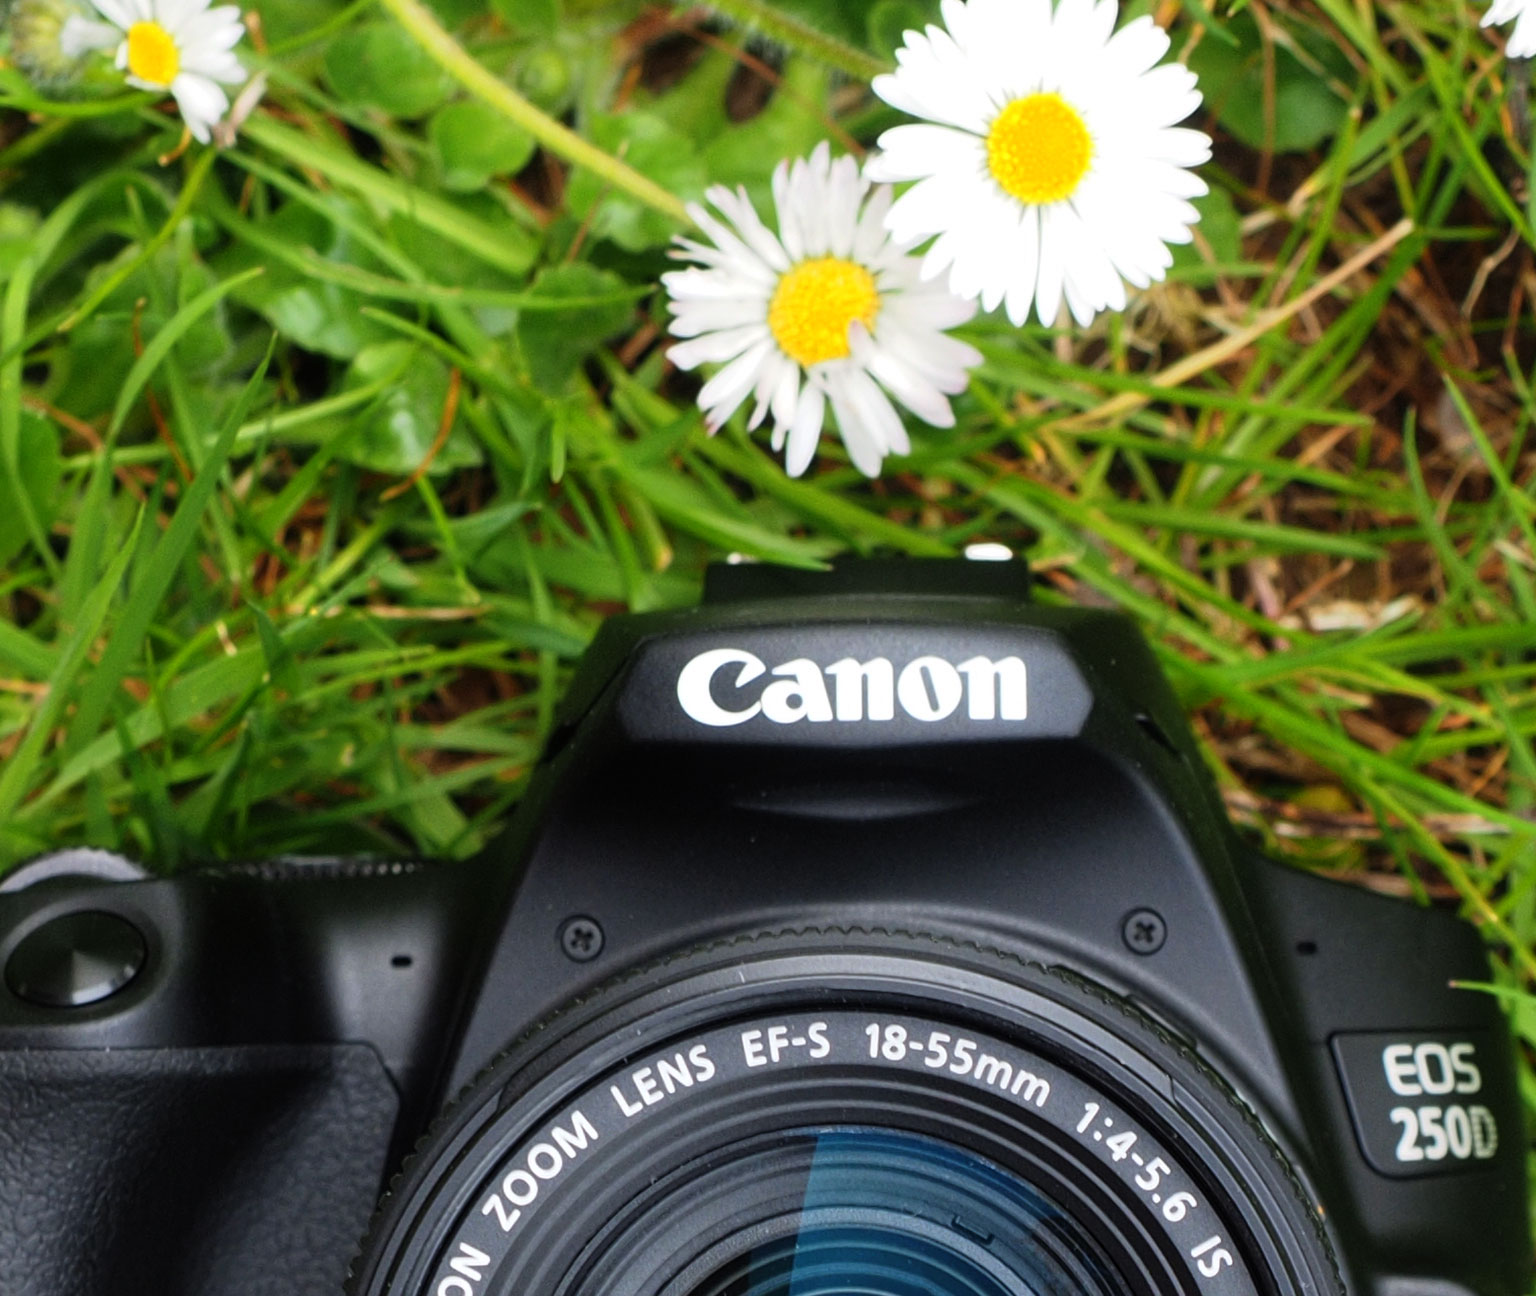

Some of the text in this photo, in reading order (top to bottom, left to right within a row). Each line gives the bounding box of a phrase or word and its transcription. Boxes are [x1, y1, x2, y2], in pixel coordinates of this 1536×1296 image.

[676, 648, 1028, 727] Canon
[1382, 1042, 1482, 1097] EOS
[481, 1110, 600, 1232] ZOOM
[610, 1044, 716, 1118] LENS
[741, 1021, 831, 1068] EF-S
[865, 1022, 1051, 1108] 18-55mm
[1076, 1102, 1198, 1223] 1:4-5.6
[1190, 1234, 1234, 1278] IS
[1389, 1105, 1498, 1162] 250D
